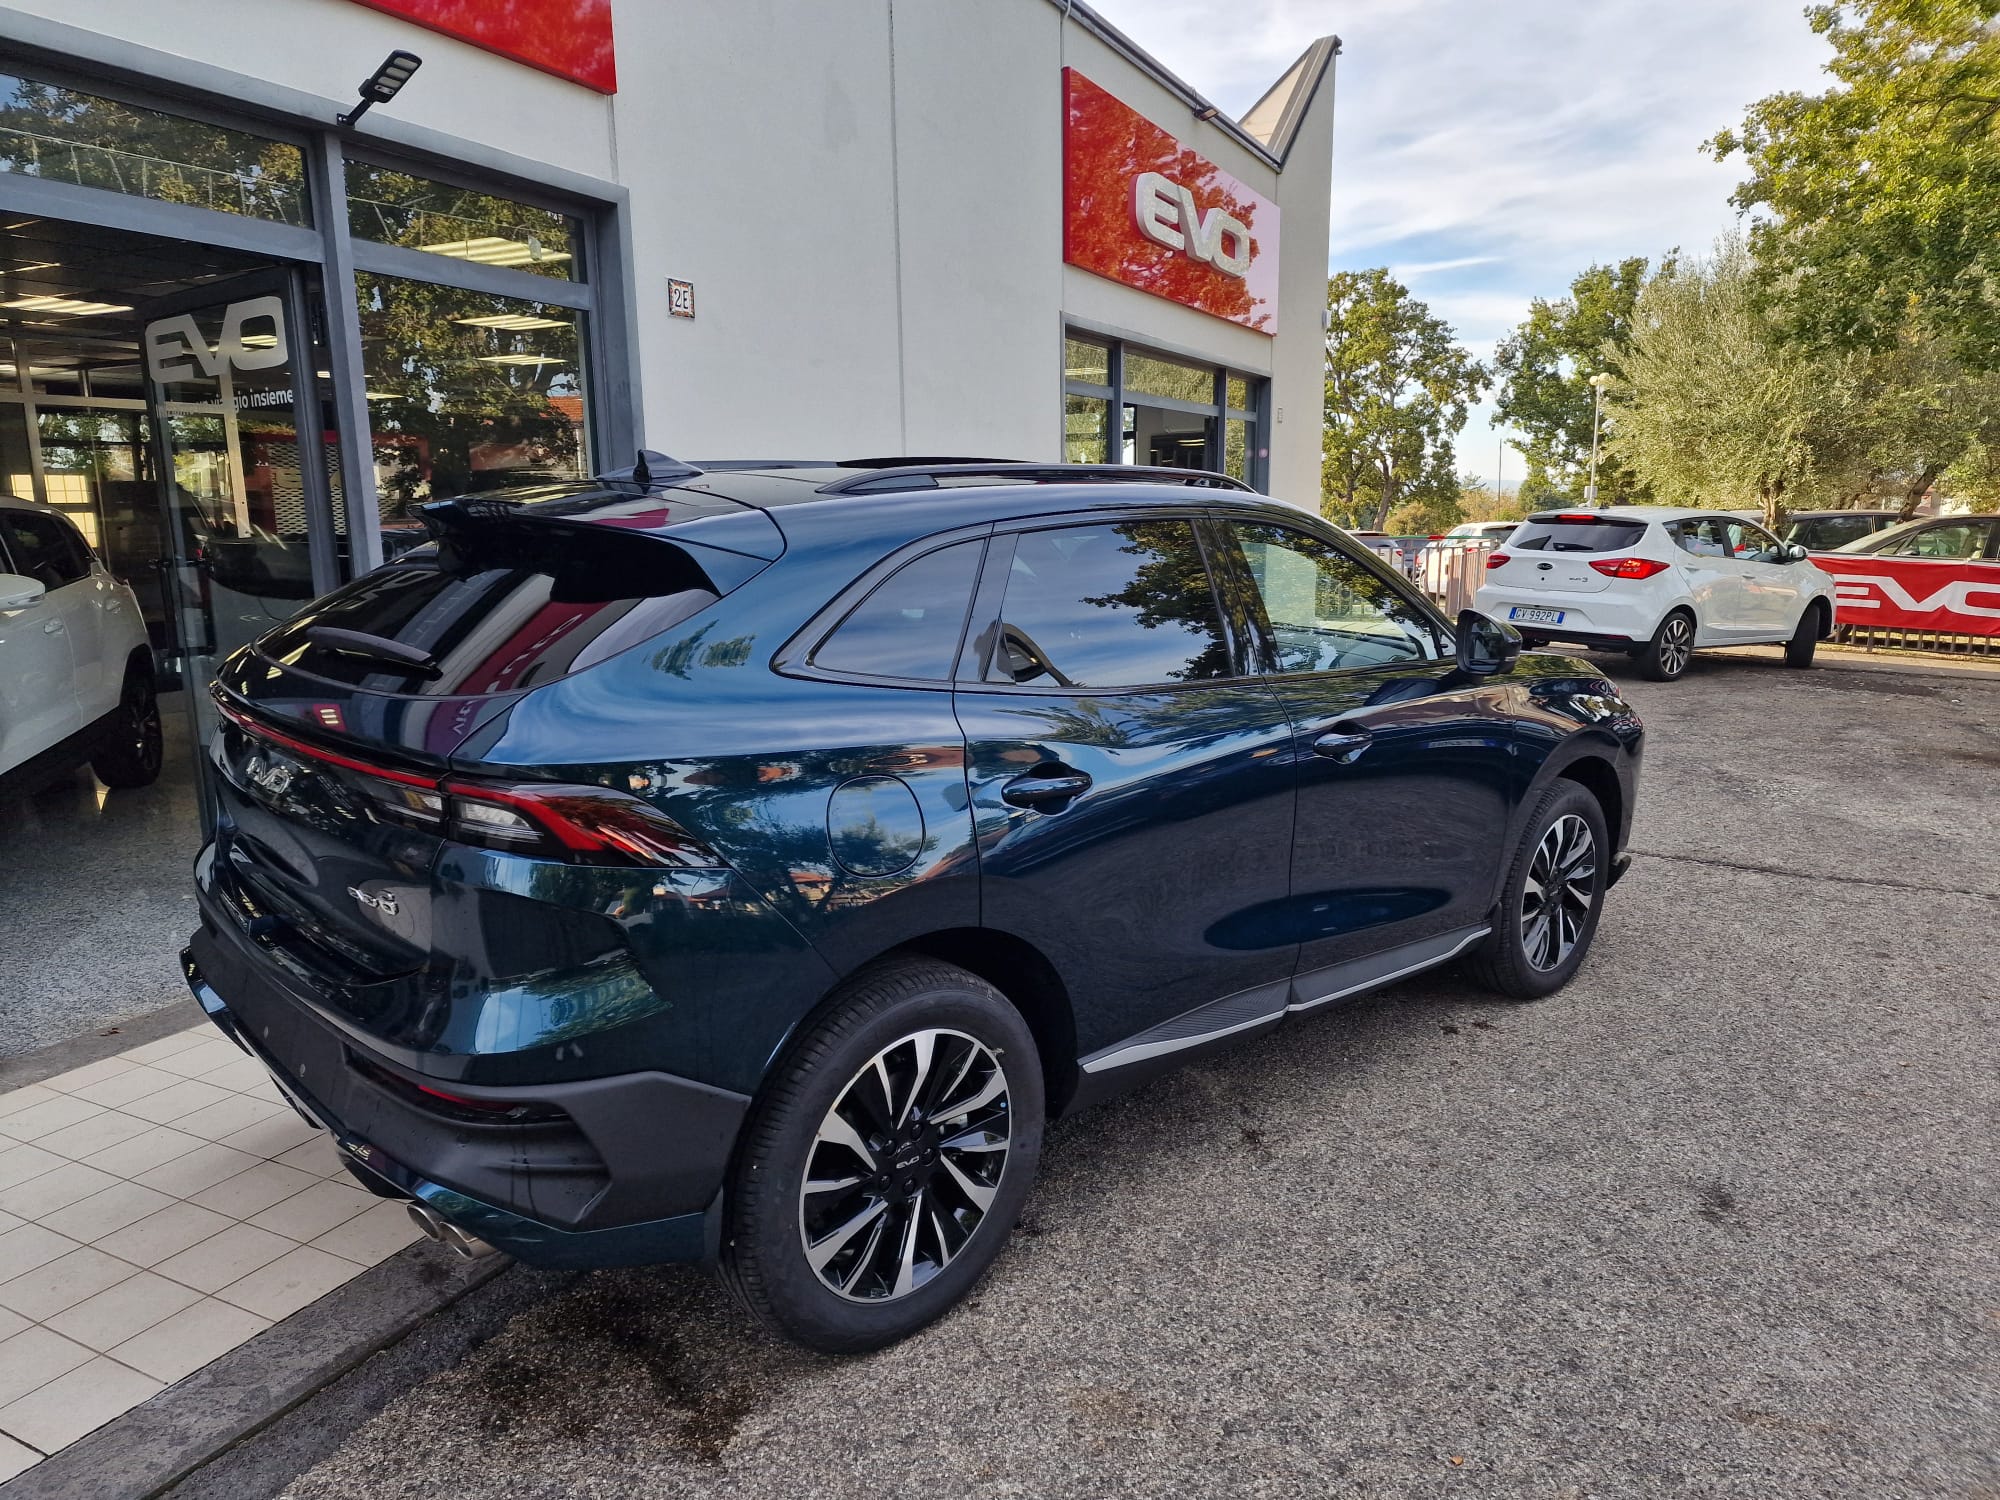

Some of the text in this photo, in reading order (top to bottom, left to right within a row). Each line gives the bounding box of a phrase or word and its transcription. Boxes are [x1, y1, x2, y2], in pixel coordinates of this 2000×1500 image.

[1135, 171, 1250, 278] EVO
[674, 288, 689, 310] 2E
[145, 296, 289, 384] EVO
[250, 386, 294, 409] insieme
[896, 1155, 920, 1168] EVO
